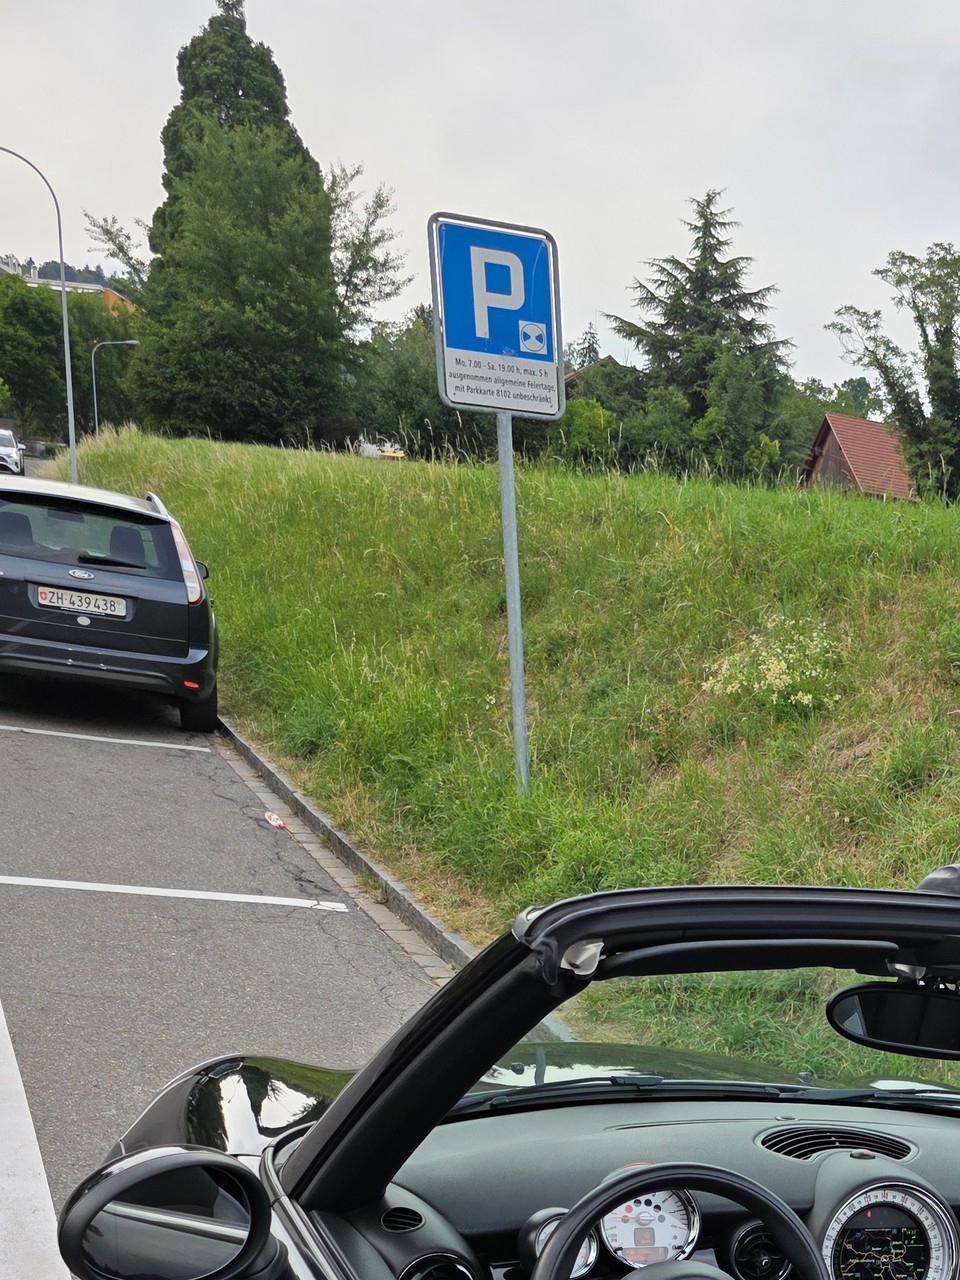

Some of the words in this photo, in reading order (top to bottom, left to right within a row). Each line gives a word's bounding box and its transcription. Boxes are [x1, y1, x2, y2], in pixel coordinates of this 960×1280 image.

[470, 245, 525, 339] P
[455, 358, 467, 367] Mo.
[468, 359, 481, 368] 7.00
[487, 362, 497, 371] Sa.
[498, 363, 515, 373] 19.00
[523, 369, 537, 377] max.
[544, 370, 549, 378] h
[449, 371, 492, 383] ausgenommen
[493, 377, 526, 388] allgemeine
[455, 384, 465, 393] mit
[466, 386, 495, 397] Parkkarte
[496, 390, 512, 399] 8102
[512, 392, 552, 404] unbeschränkt
